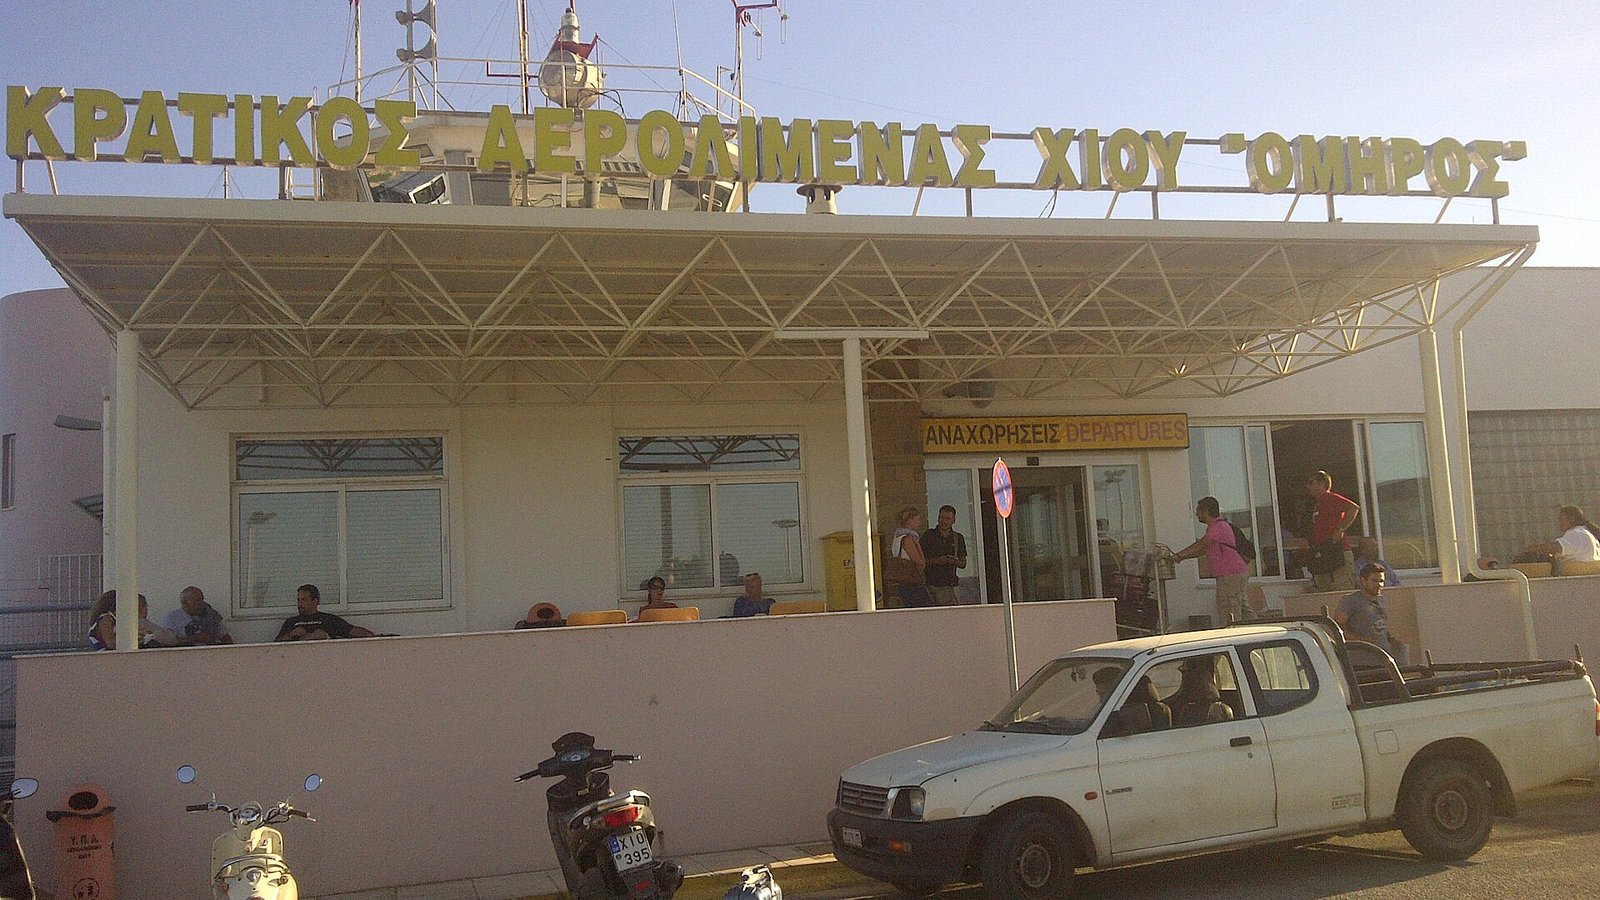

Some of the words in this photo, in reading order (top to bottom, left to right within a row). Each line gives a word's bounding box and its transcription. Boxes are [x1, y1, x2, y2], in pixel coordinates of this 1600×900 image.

[6, 86, 421, 171] ΚΡΑΤΙΚΟΣ
[478, 104, 995, 187] ΑΕΡΟΛΙΜΕΝΑΣ
[1032, 127, 1187, 192] ΧΙΟΥ
[925, 422, 1060, 446] ΑΝΑΧΩΡΗΣΕΙΣ
[1066, 419, 1186, 443] DEPARTURES
[624, 847, 650, 865] 395
